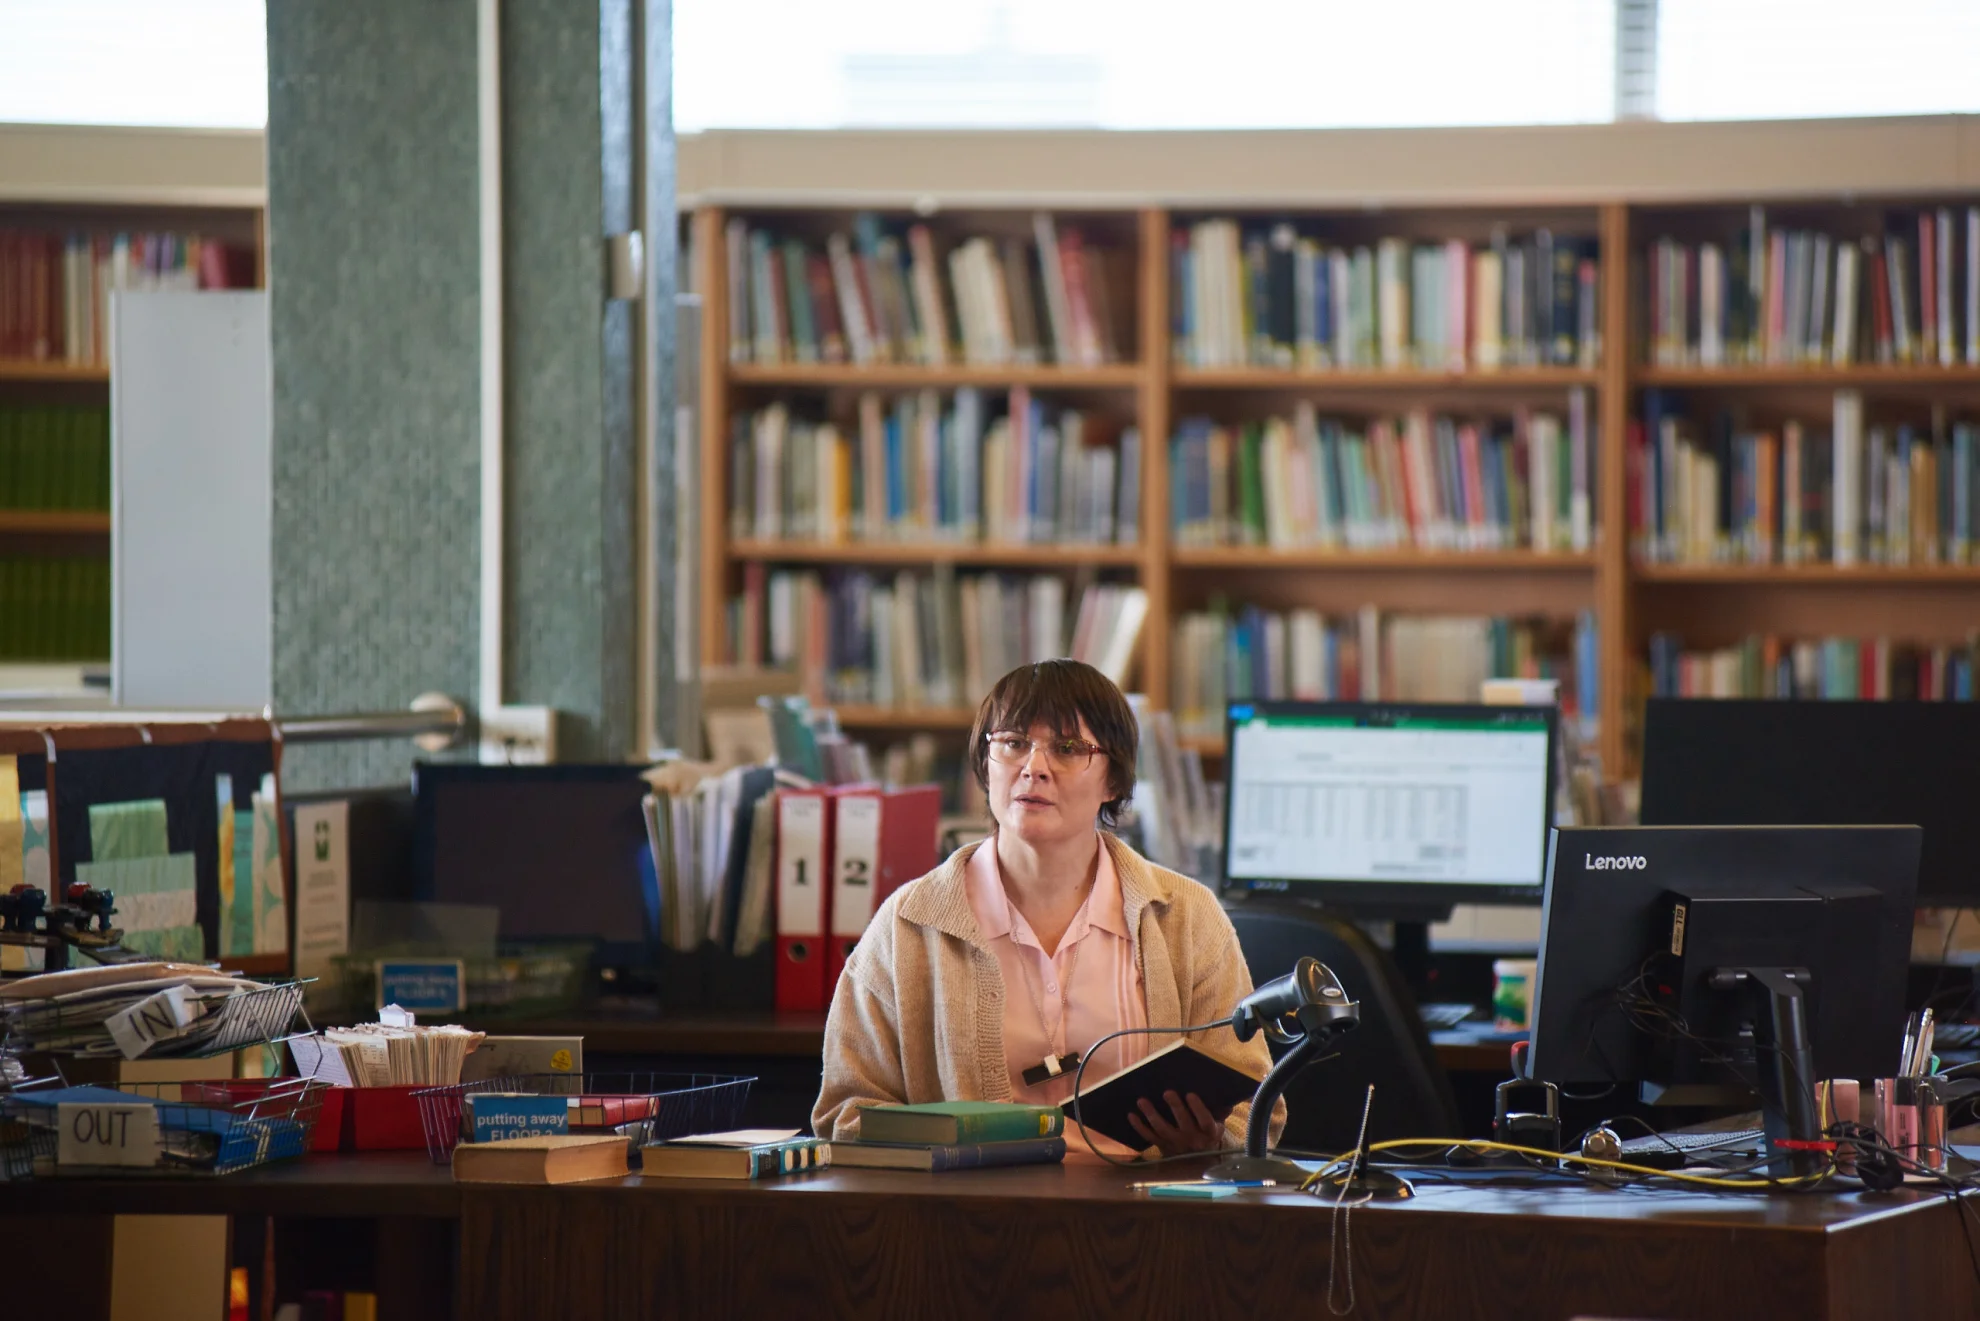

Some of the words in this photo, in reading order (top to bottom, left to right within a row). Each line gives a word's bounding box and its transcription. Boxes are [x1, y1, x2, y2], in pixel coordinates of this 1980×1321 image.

[794, 858, 808, 887] 1
[843, 858, 868, 887] 2
[1585, 853, 1647, 870] Lenovo
[128, 1001, 174, 1043] IN
[73, 1108, 133, 1148] OUT
[477, 1112, 526, 1128] putting
[530, 1113, 566, 1128] away
